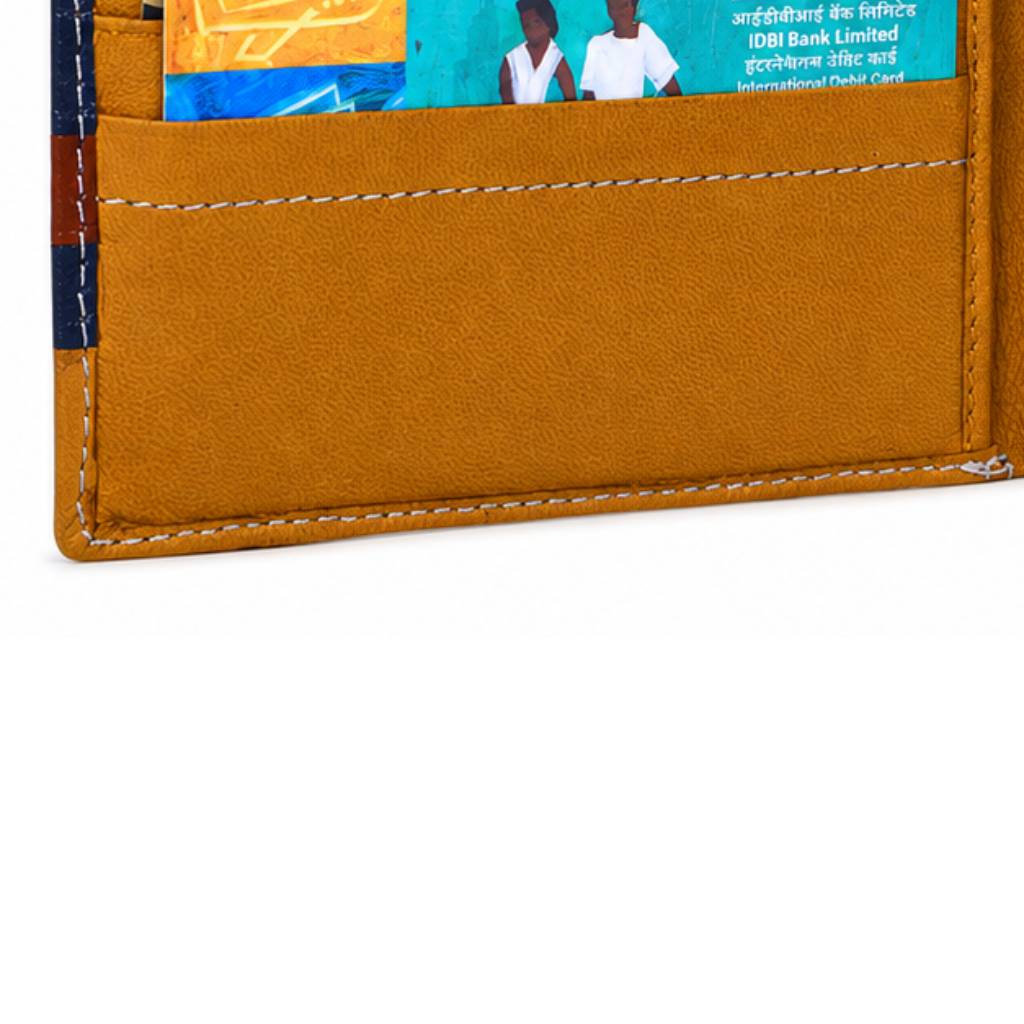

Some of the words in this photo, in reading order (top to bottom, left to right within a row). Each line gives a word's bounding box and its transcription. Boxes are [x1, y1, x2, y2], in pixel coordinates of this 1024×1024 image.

[749, 32, 783, 49] IDBI
[788, 28, 830, 47] Bank
[835, 24, 899, 45] Limited
